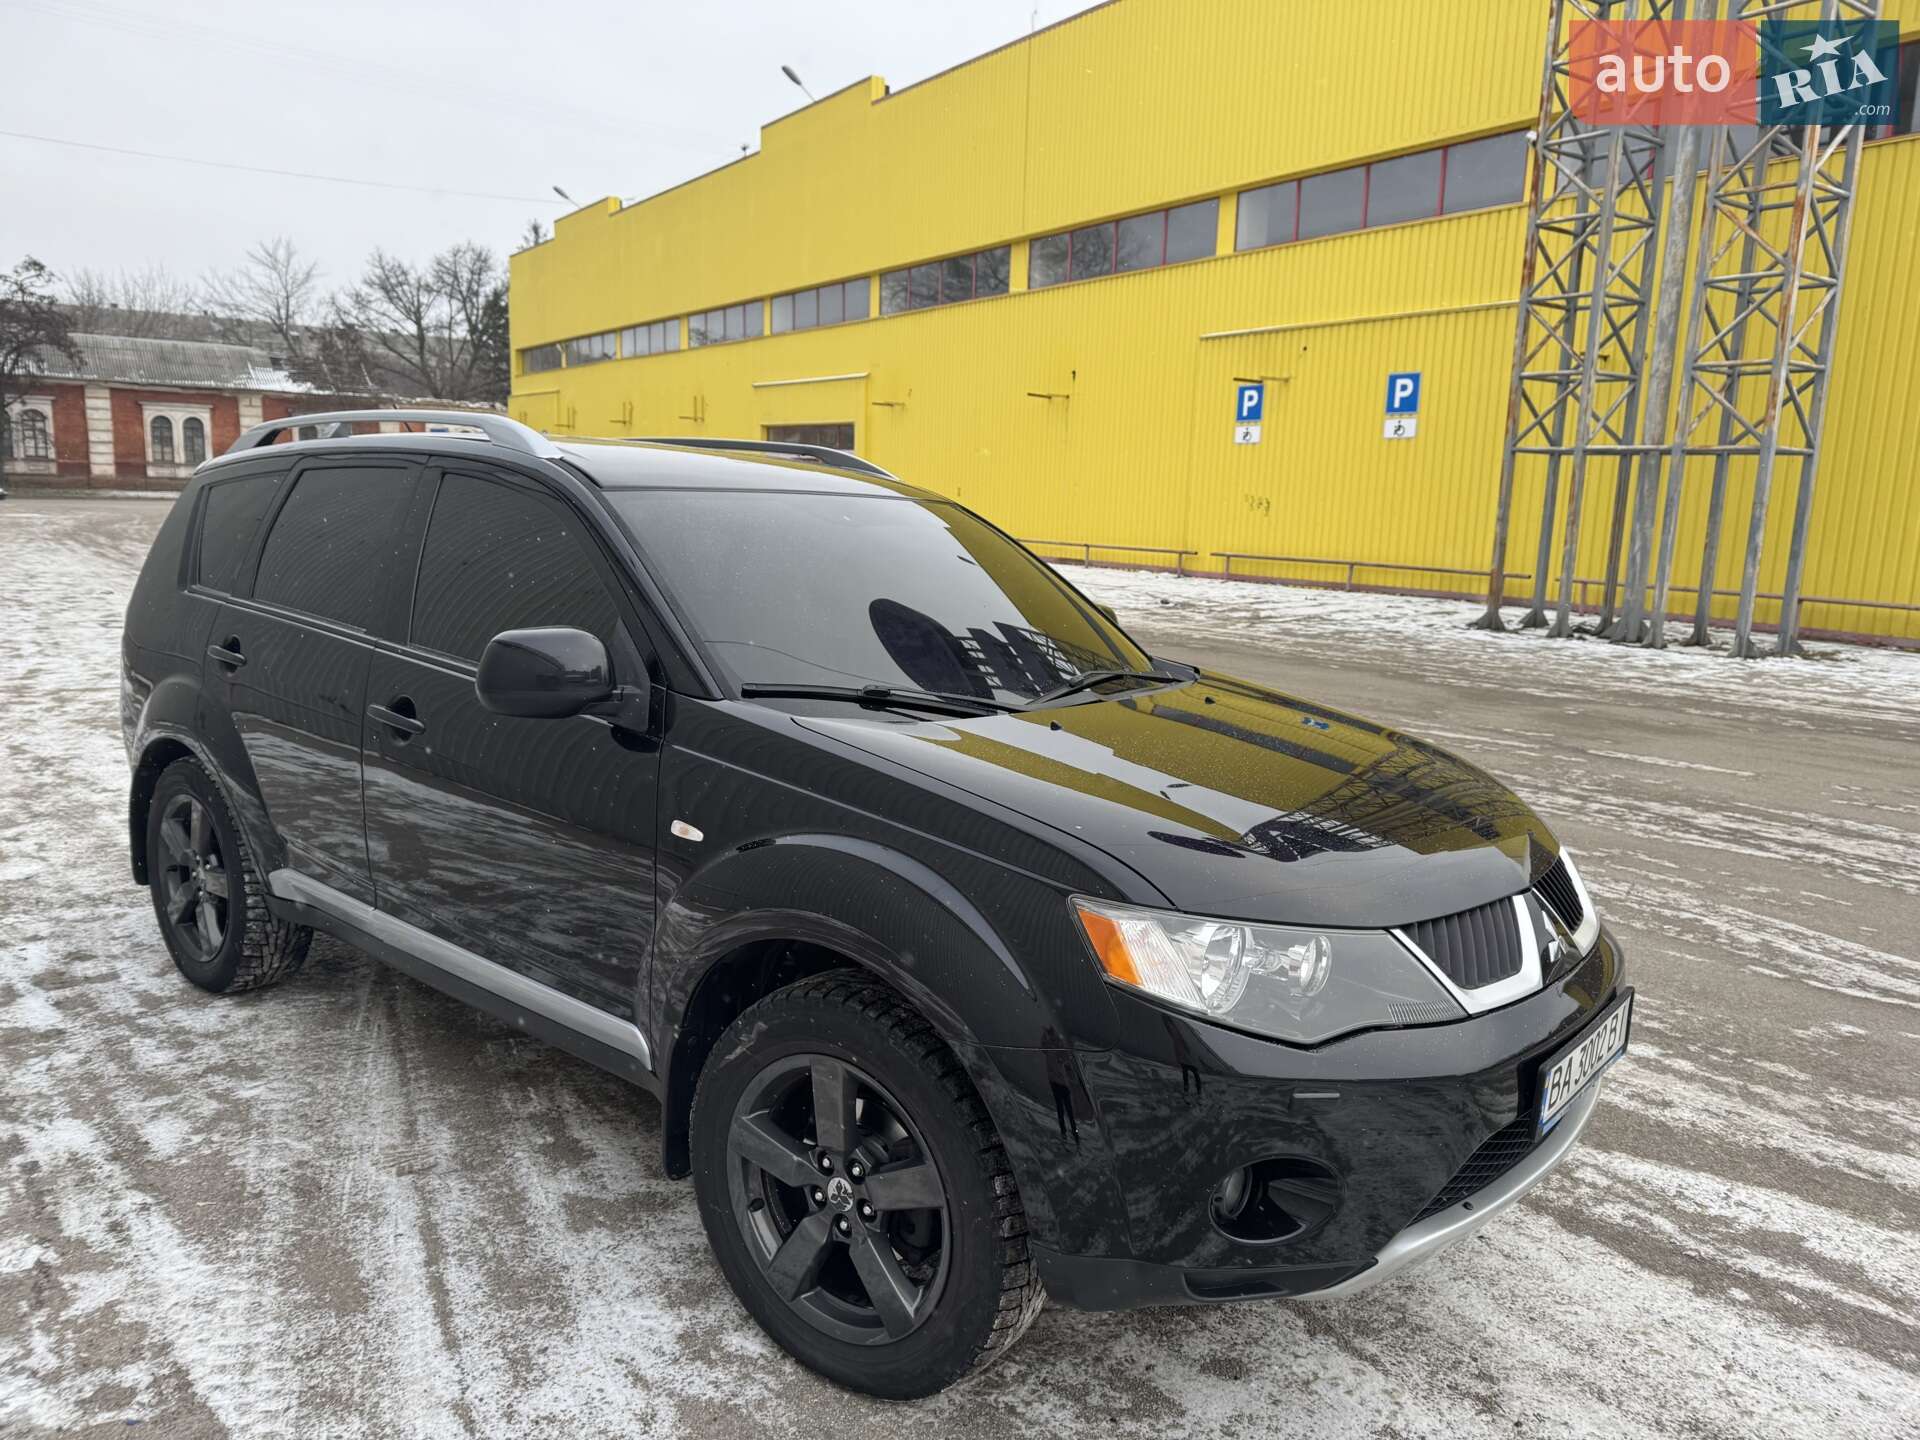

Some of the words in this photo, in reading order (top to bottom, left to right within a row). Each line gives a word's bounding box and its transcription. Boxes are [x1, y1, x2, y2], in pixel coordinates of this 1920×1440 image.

[1242, 389, 1259, 417] P
[1393, 378, 1414, 408] P
[1548, 1056, 1573, 1110] BA
[1574, 1027, 1608, 1085] 3002
